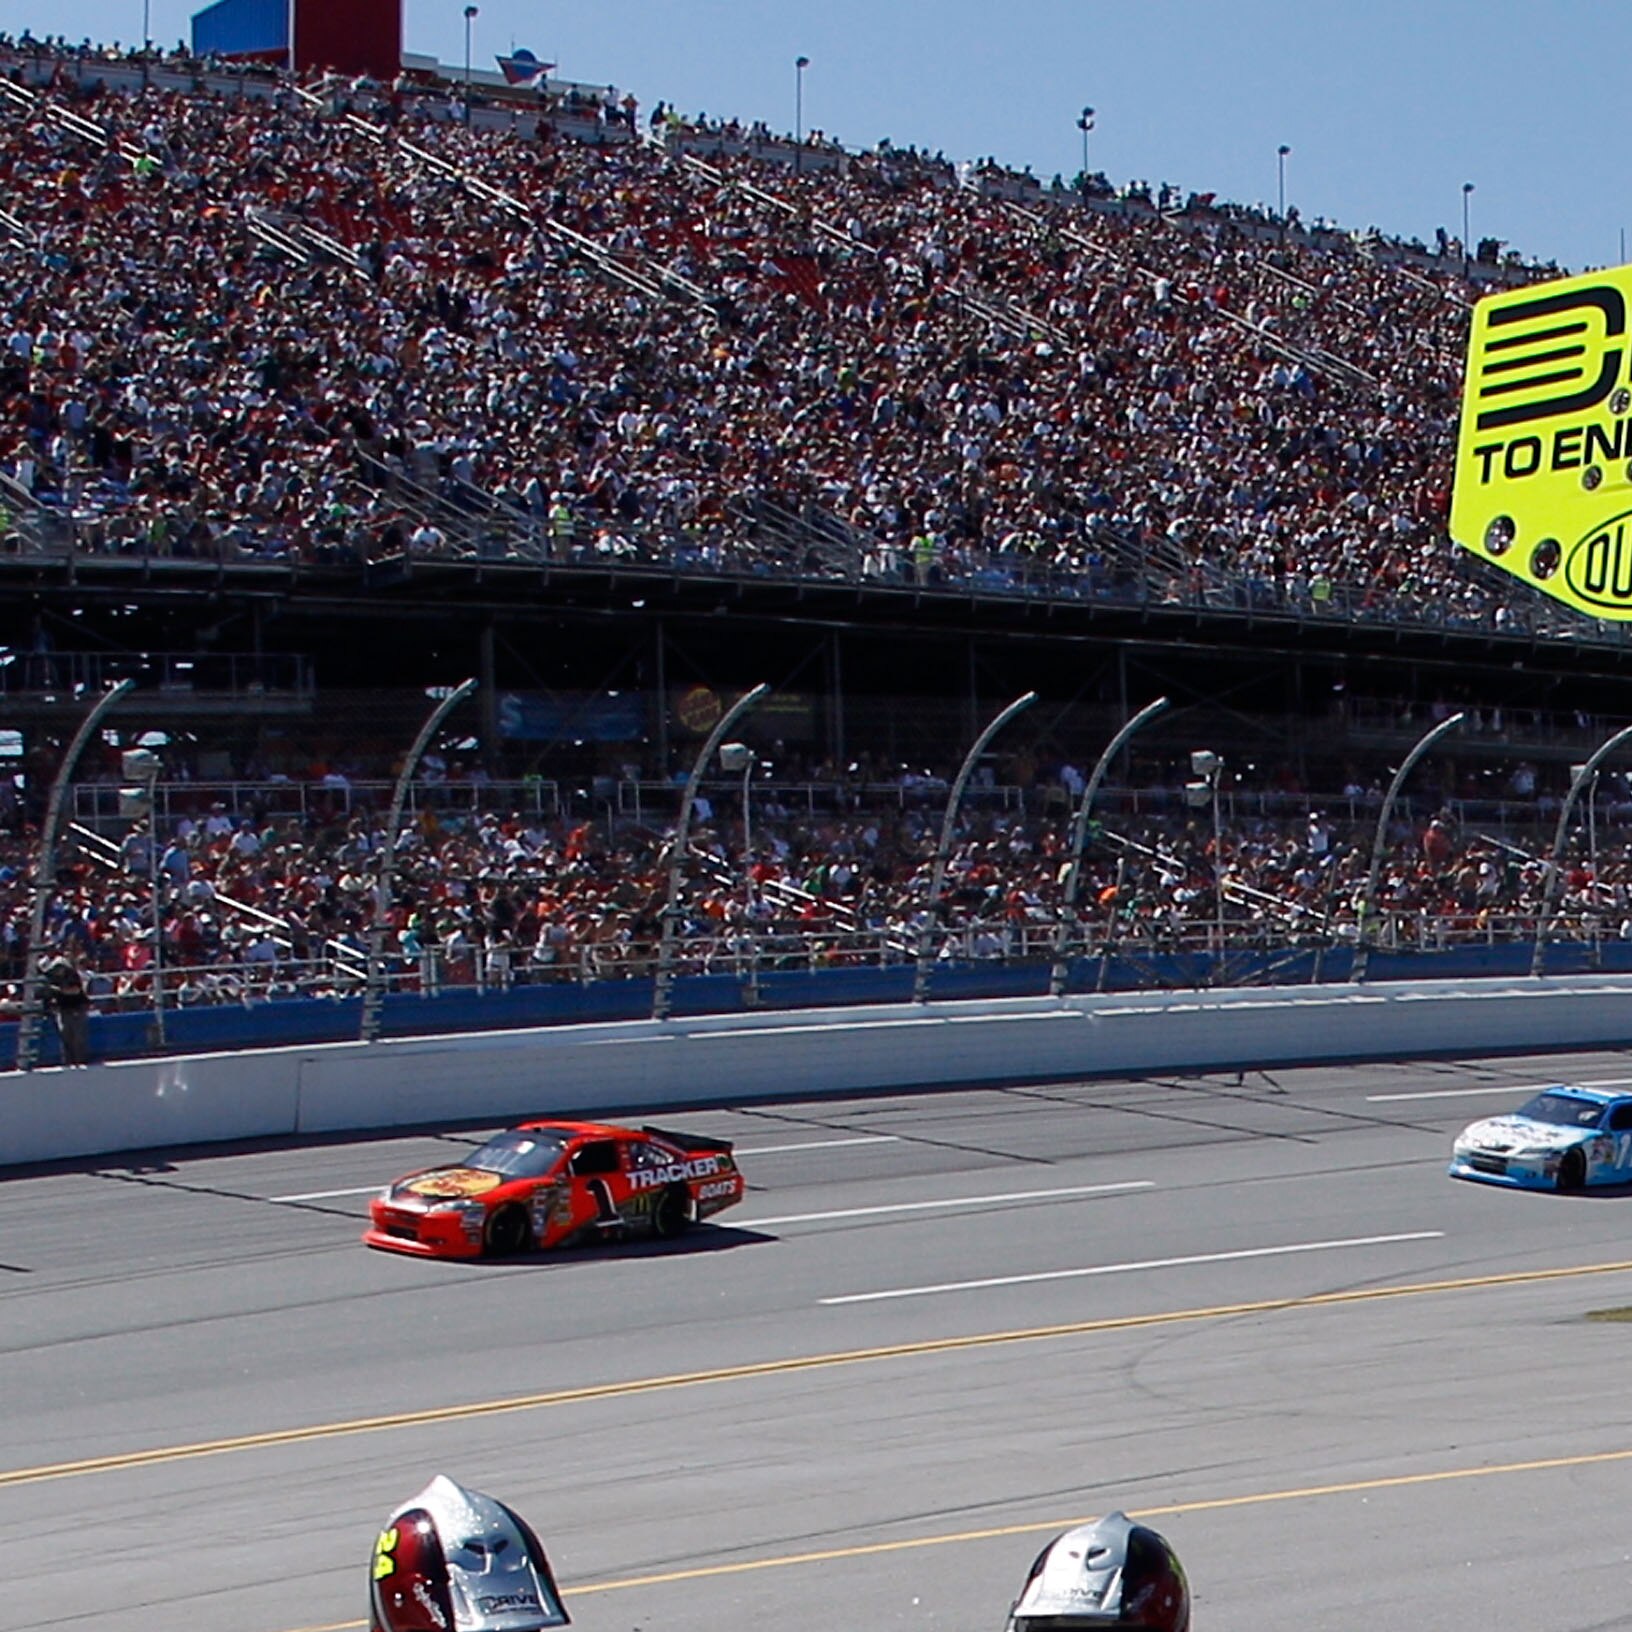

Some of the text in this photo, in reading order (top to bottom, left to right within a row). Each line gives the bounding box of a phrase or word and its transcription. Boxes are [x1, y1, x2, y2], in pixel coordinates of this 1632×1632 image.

[1474, 436, 1541, 485] TO
[625, 1157, 720, 1190] TRACKER
[699, 1178, 737, 1200] BOATS
[587, 1178, 624, 1227] 1
